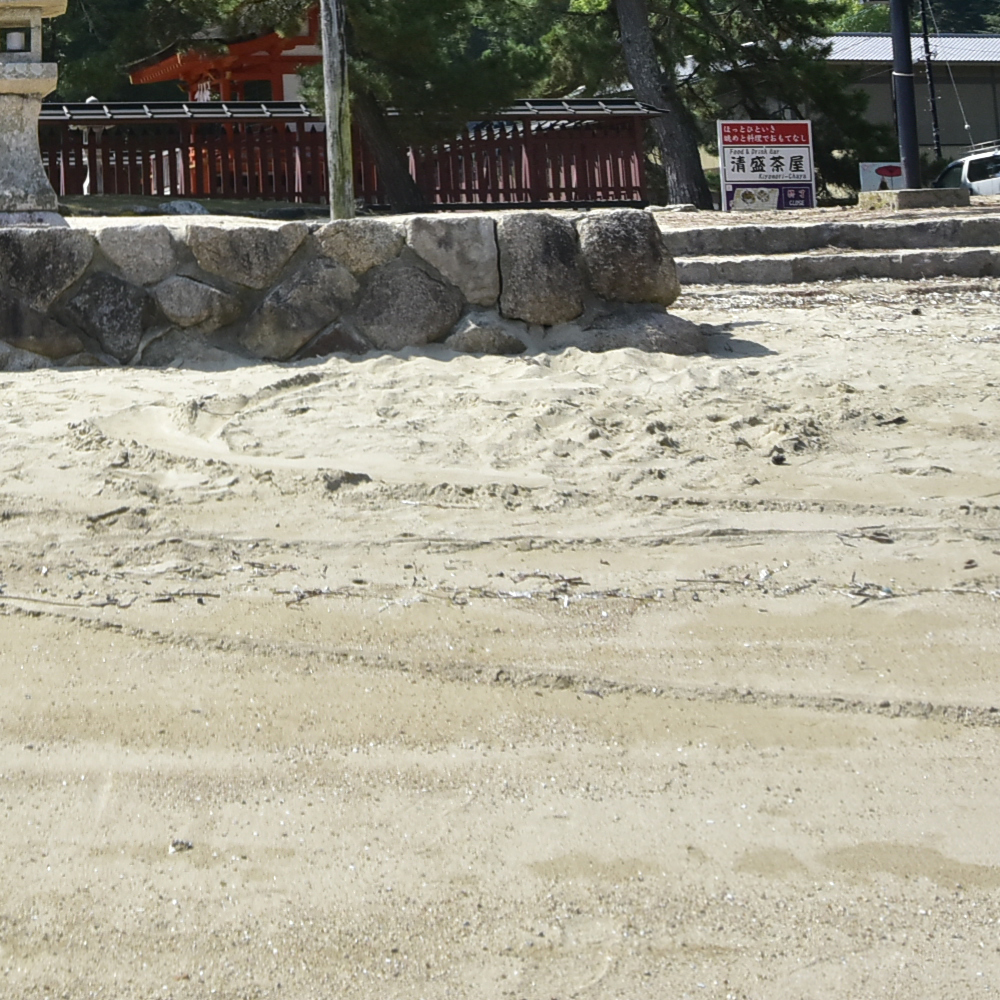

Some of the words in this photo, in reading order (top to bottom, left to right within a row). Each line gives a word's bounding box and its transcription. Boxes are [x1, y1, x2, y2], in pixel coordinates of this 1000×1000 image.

[723, 125, 775, 133] ほっとひといき
[723, 134, 806, 142] 眺めと料理でおもてなし
[731, 155, 804, 172] 清盛茶屋
